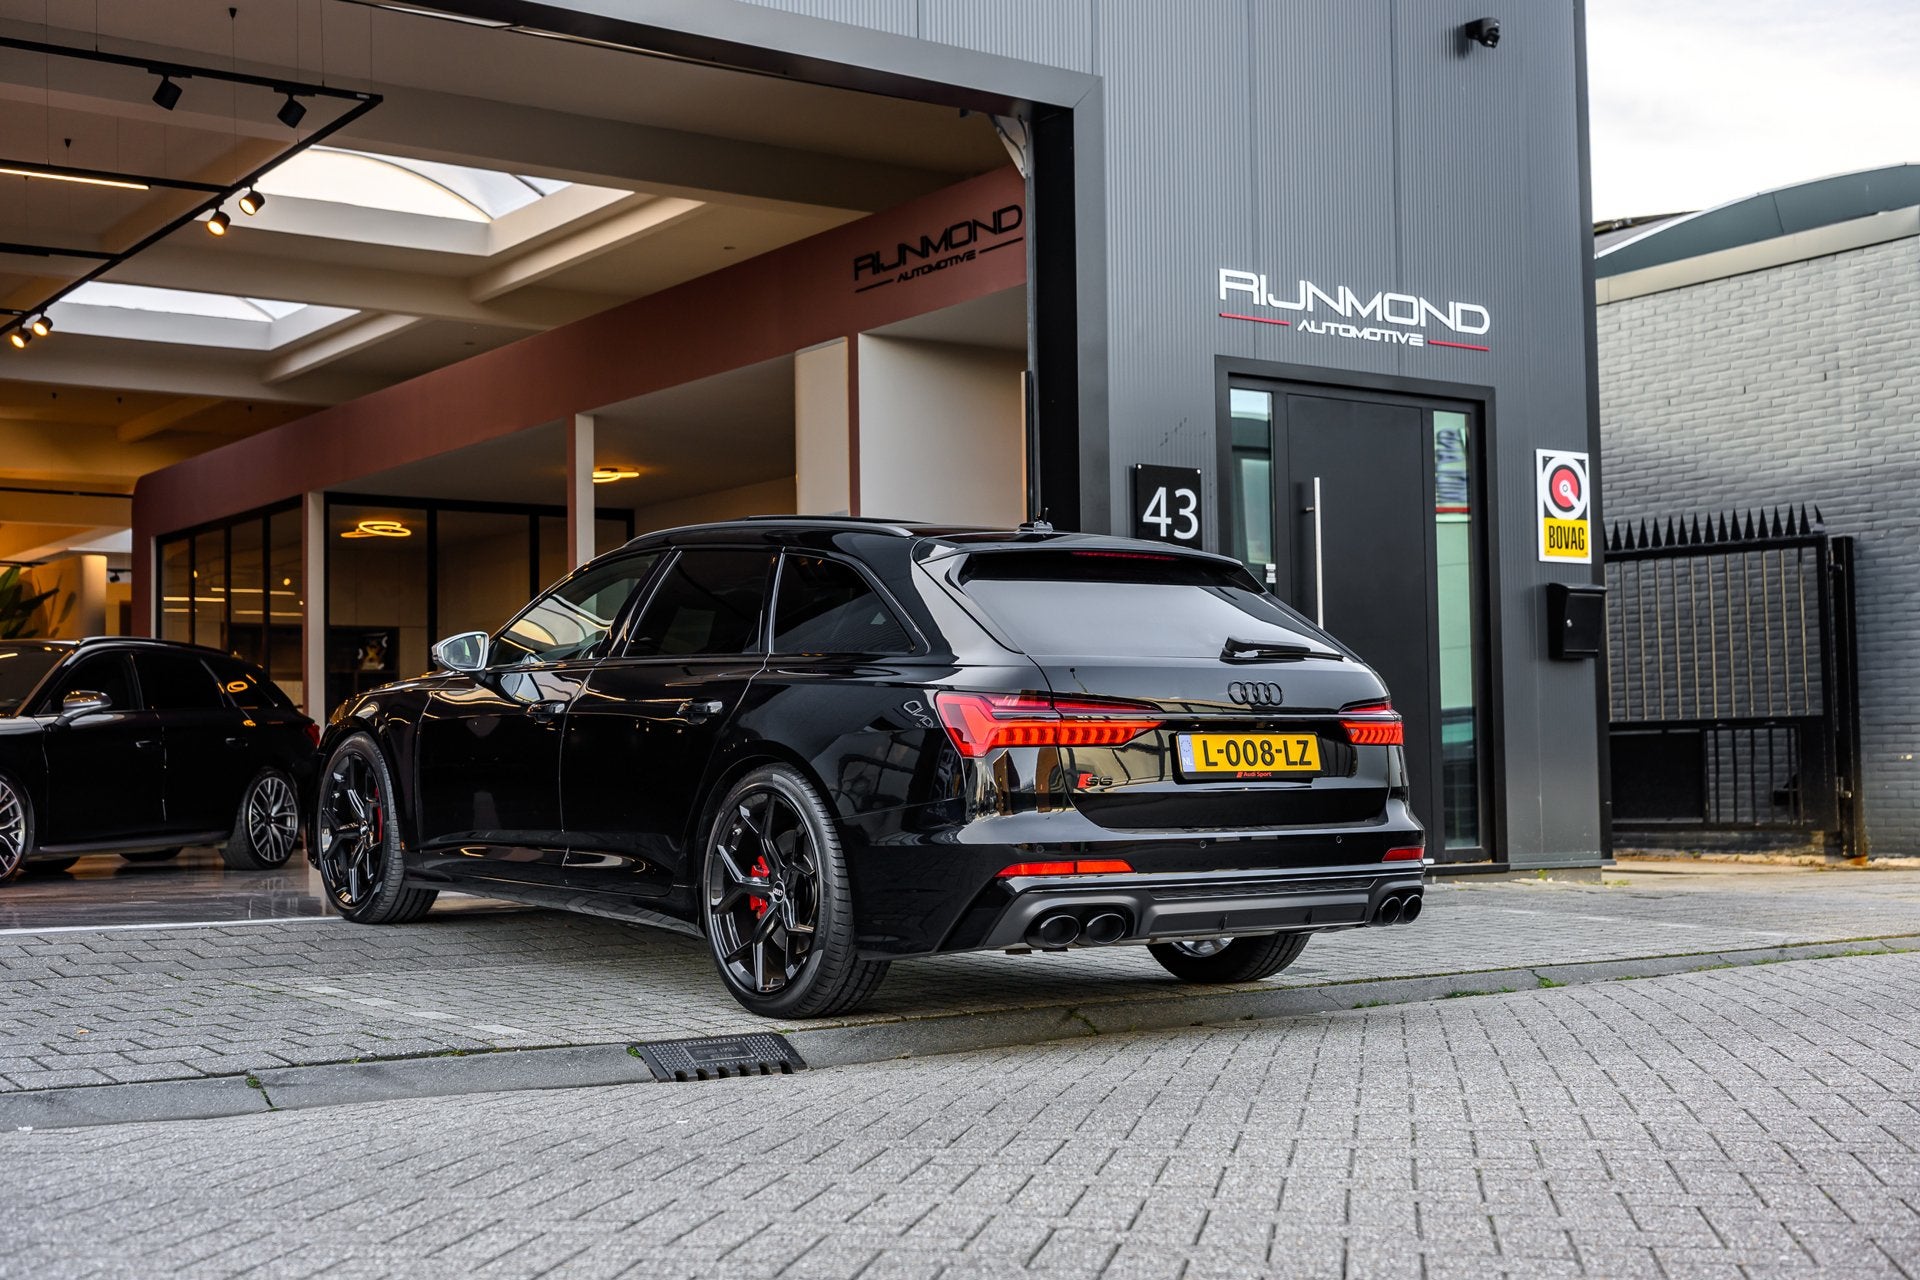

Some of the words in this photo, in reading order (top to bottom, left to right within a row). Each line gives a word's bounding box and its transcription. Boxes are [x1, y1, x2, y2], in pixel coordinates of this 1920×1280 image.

[854, 204, 1023, 281] RIJNMOND
[897, 250, 977, 282] AUTOMOTIVE
[1218, 268, 1491, 335] RIJNMOND
[1297, 319, 1425, 347] AUTOMOTIVE
[1142, 486, 1199, 540] 43
[1548, 525, 1585, 551] BOVAG
[1182, 756, 1193, 766] NL
[1202, 740, 1312, 767] L-008-LZ
[1085, 775, 1114, 786] S6
